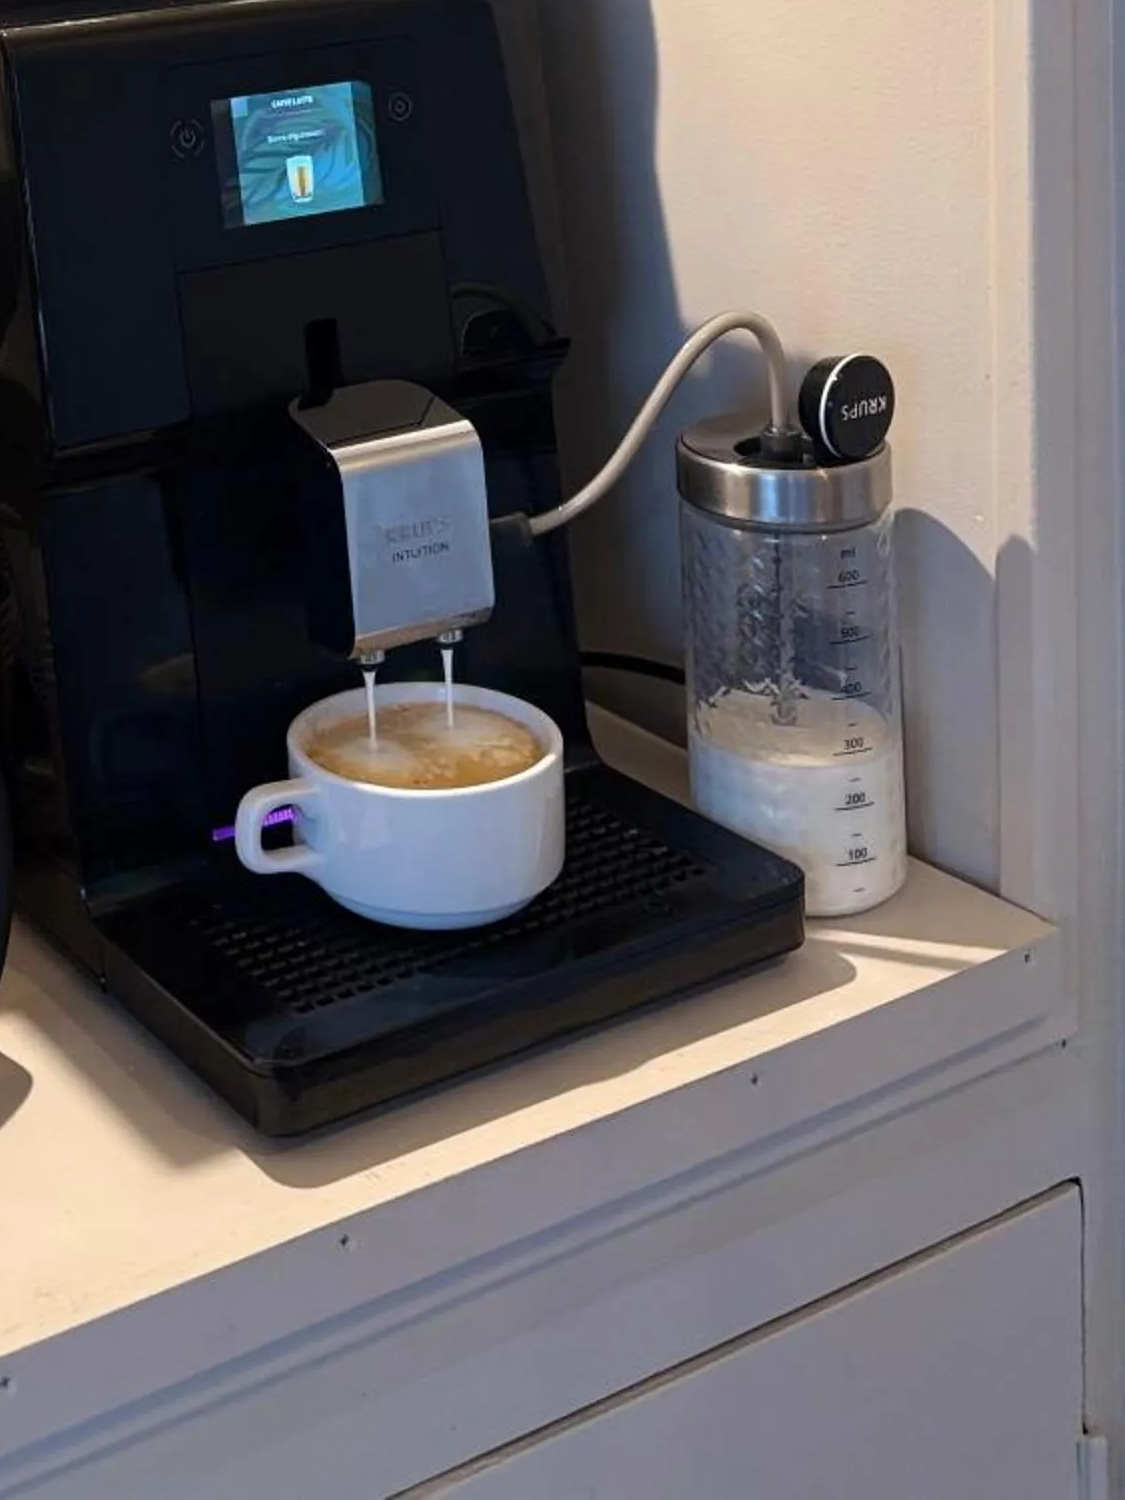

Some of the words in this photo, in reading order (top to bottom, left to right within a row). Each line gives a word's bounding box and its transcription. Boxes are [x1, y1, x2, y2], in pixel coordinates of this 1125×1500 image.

[841, 395, 887, 421] KRUPS
[391, 541, 450, 564] INTUITION
[838, 570, 860, 583] 600
[844, 737, 865, 750] 300
[845, 792, 866, 806] 200
[848, 847, 869, 861] 100
